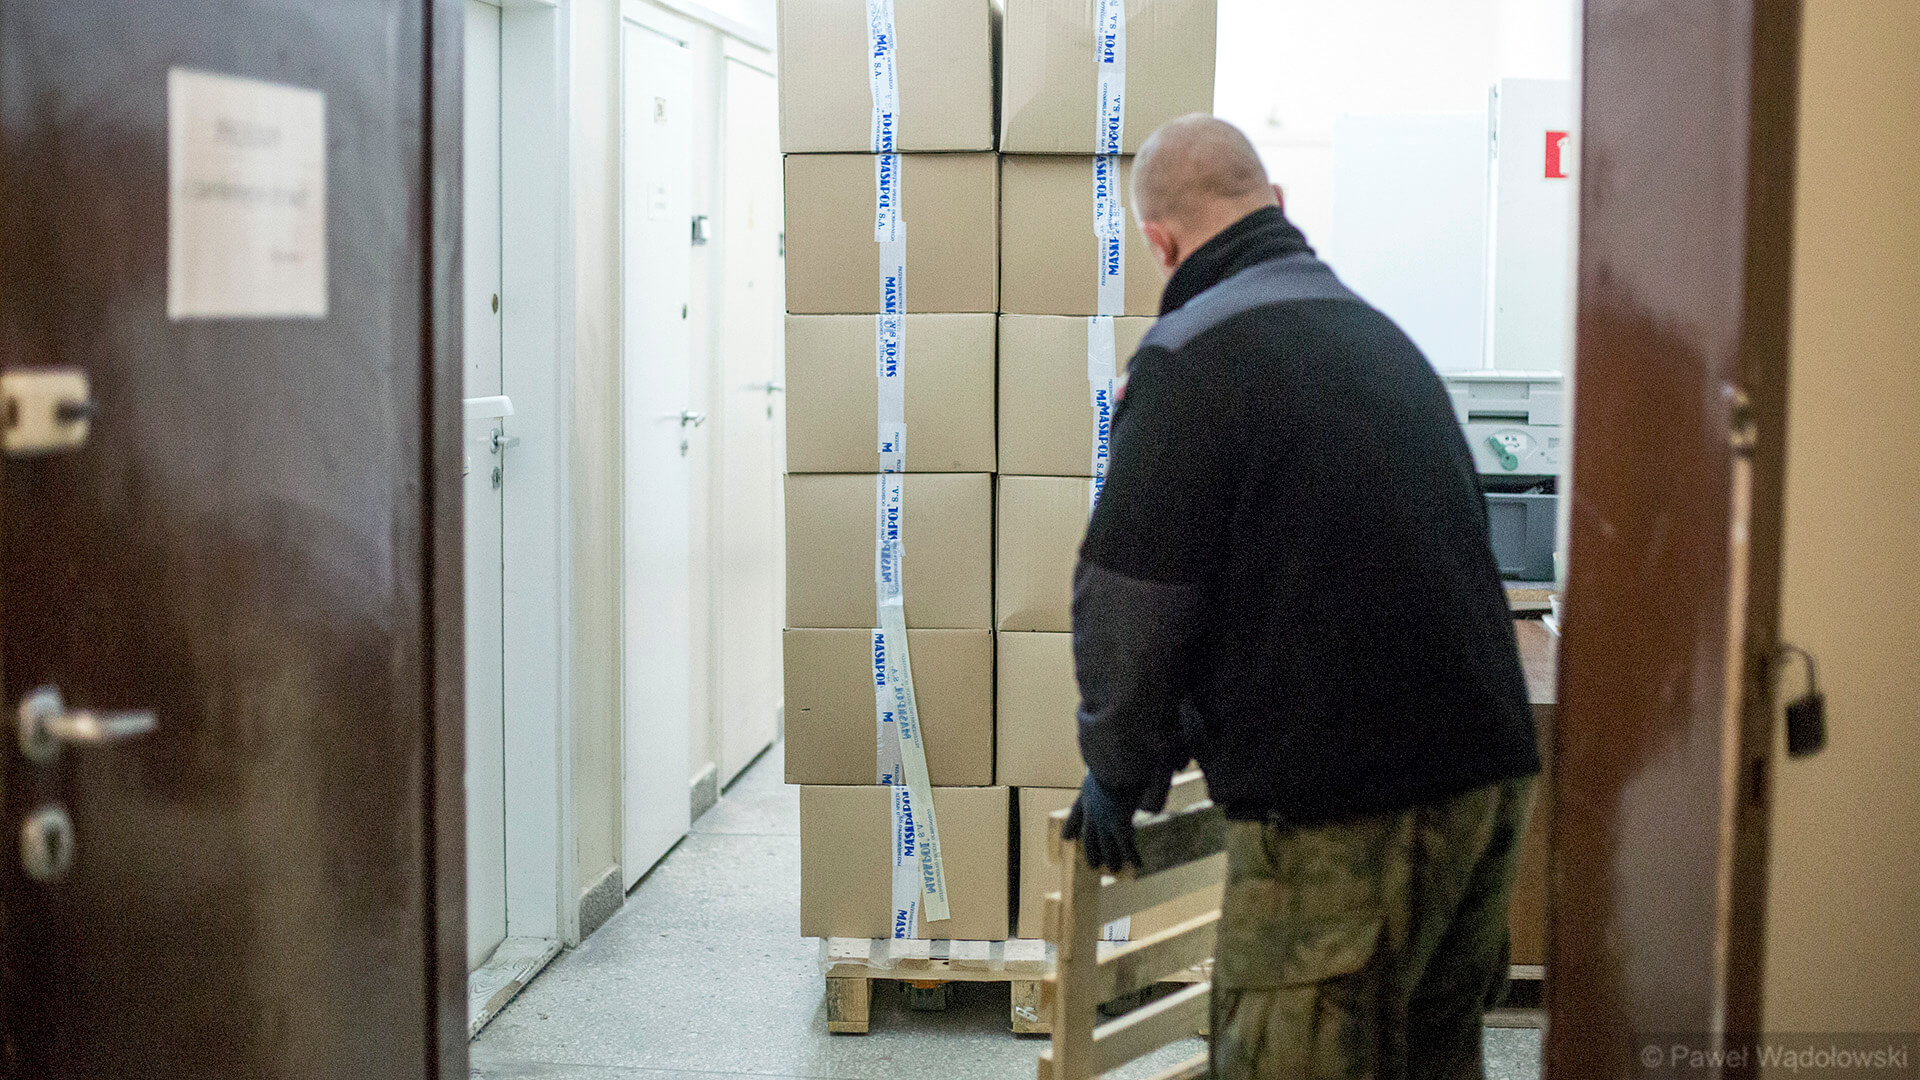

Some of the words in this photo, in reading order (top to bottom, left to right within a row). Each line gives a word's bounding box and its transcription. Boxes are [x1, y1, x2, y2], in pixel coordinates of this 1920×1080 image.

[1113, 94, 1121, 112] S.A.
[879, 154, 892, 209] MASKPOL
[878, 212, 886, 230] S.A.
[1098, 402, 1110, 459] MASKPOL
[891, 485, 900, 503] S.A.
